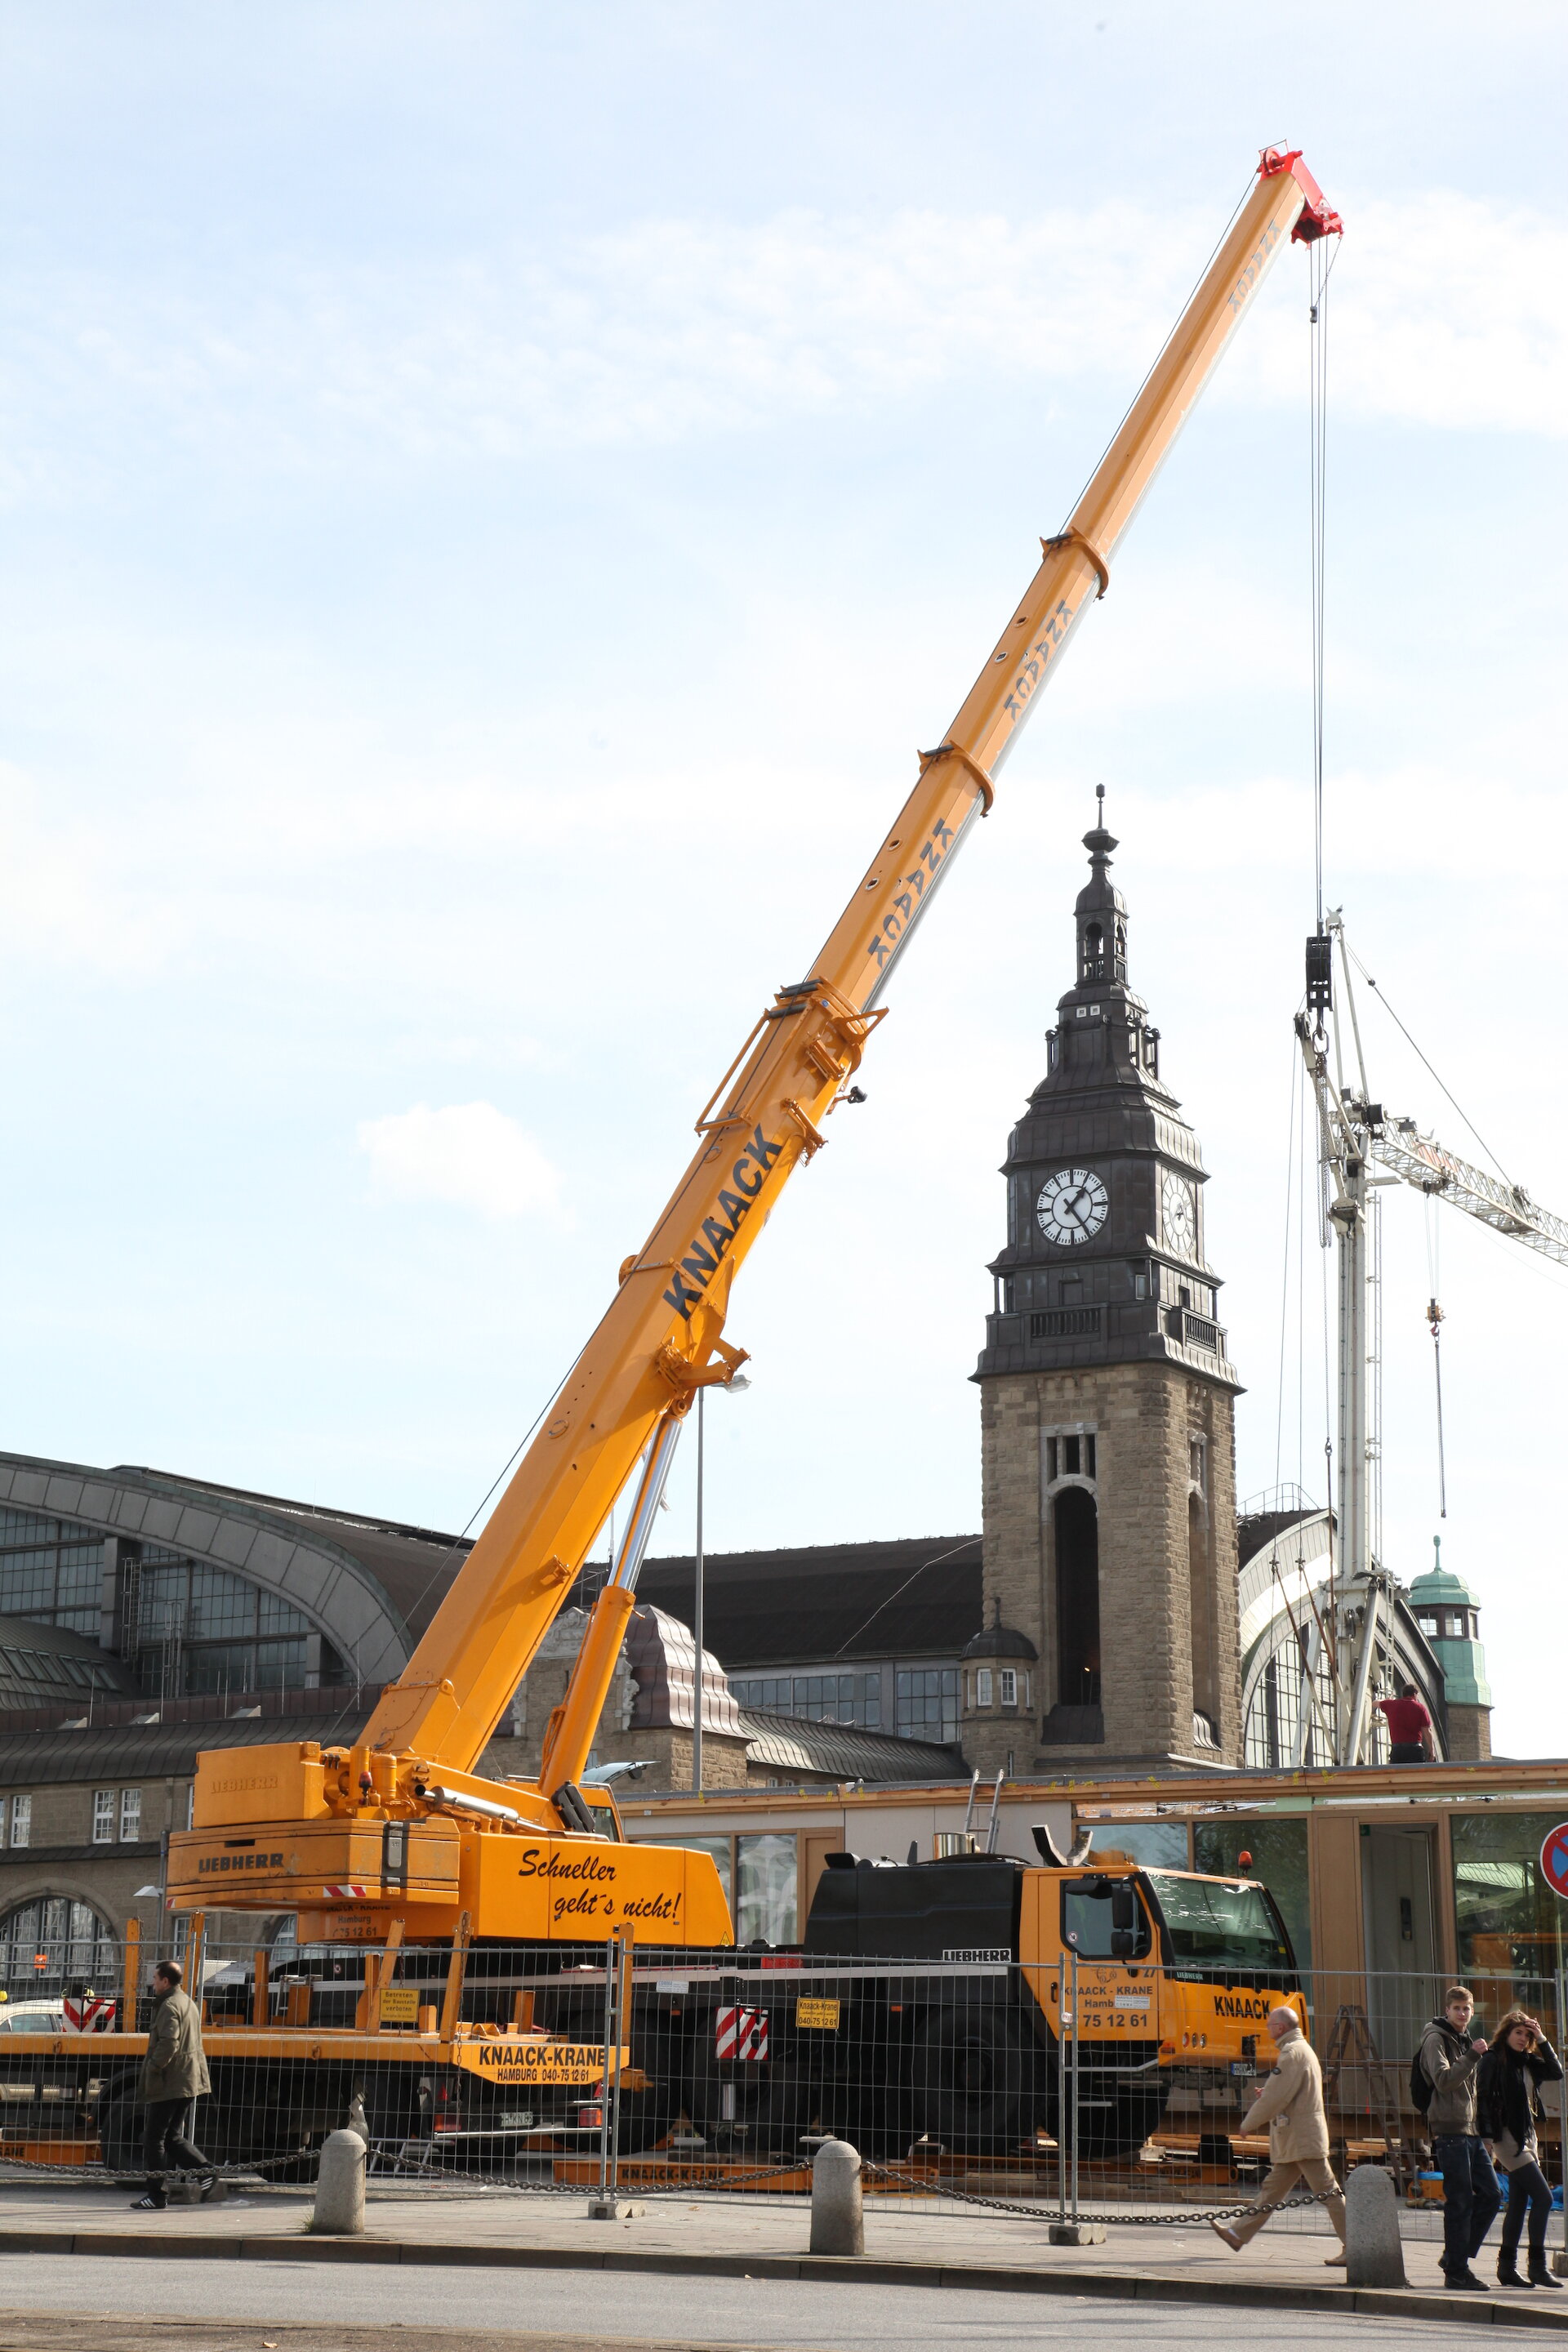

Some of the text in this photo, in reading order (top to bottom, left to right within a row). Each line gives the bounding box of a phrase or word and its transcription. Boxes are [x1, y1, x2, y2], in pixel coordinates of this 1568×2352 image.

[1003, 599, 1073, 721] KNAACK
[867, 817, 955, 969] KNAACK
[662, 1123, 782, 1321] KNAACK
[210, 1775, 278, 1794] LIEBHERR
[198, 1853, 284, 1873] LIEBHERR
[518, 1849, 617, 1882] Schneller
[623, 1892, 682, 1919] nicht!
[337, 1916, 372, 1924] Hamburg
[352, 1927, 363, 1937] 12
[366, 1927, 377, 1936] 61
[943, 1949, 1010, 1962] LIEBHERR
[1177, 1971, 1204, 1980] LIEBHERR
[1064, 1986, 1107, 1995] KAACK
[1116, 1986, 1153, 1995] KRANE
[800, 2001, 838, 2011] Knaack-Krane
[1214, 1996, 1271, 2020] KNAACK
[1083, 2014, 1147, 2027] 75 12 61
[479, 2046, 606, 2067] KNAACK-KRANE
[497, 2068, 537, 2082] HAMBURG
[621, 2168, 725, 2180] KNAACK-KRANE
